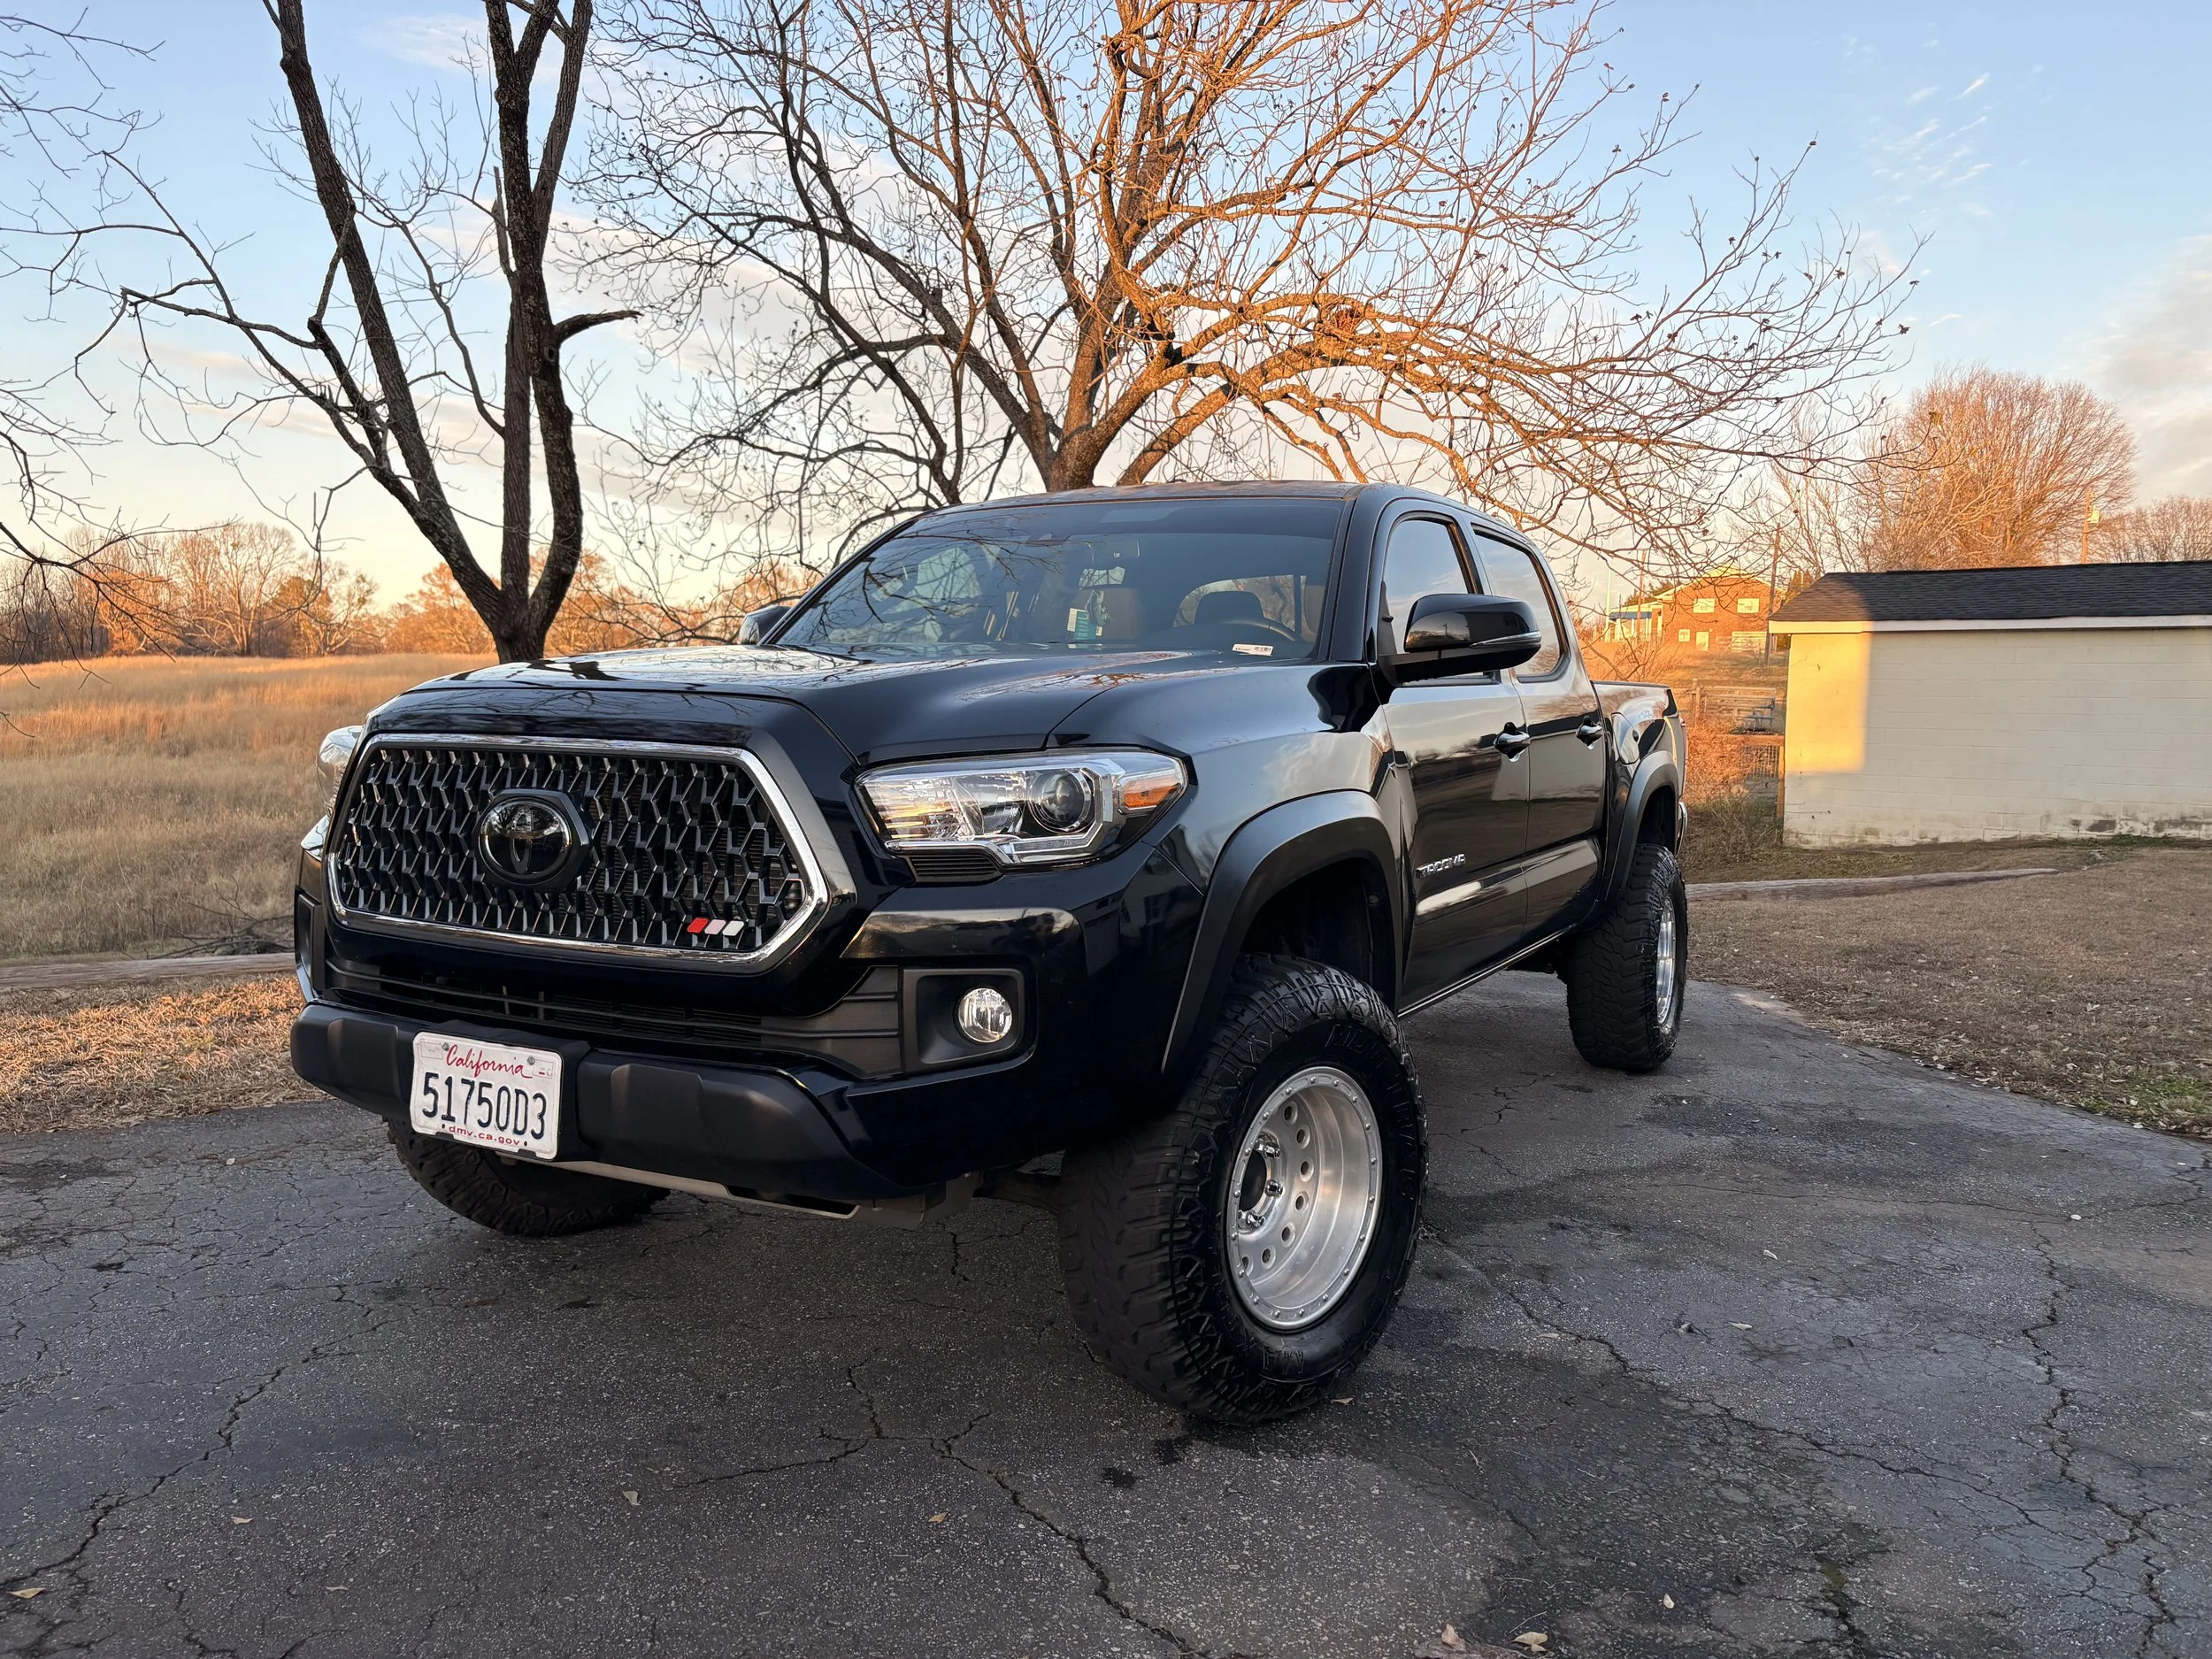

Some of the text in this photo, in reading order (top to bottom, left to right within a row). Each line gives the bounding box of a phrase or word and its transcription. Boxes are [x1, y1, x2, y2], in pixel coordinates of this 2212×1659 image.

[446, 1044, 533, 1079] California
[422, 1071, 547, 1140] 51750D3
[449, 1125, 520, 1146] dmv.ca.gov
